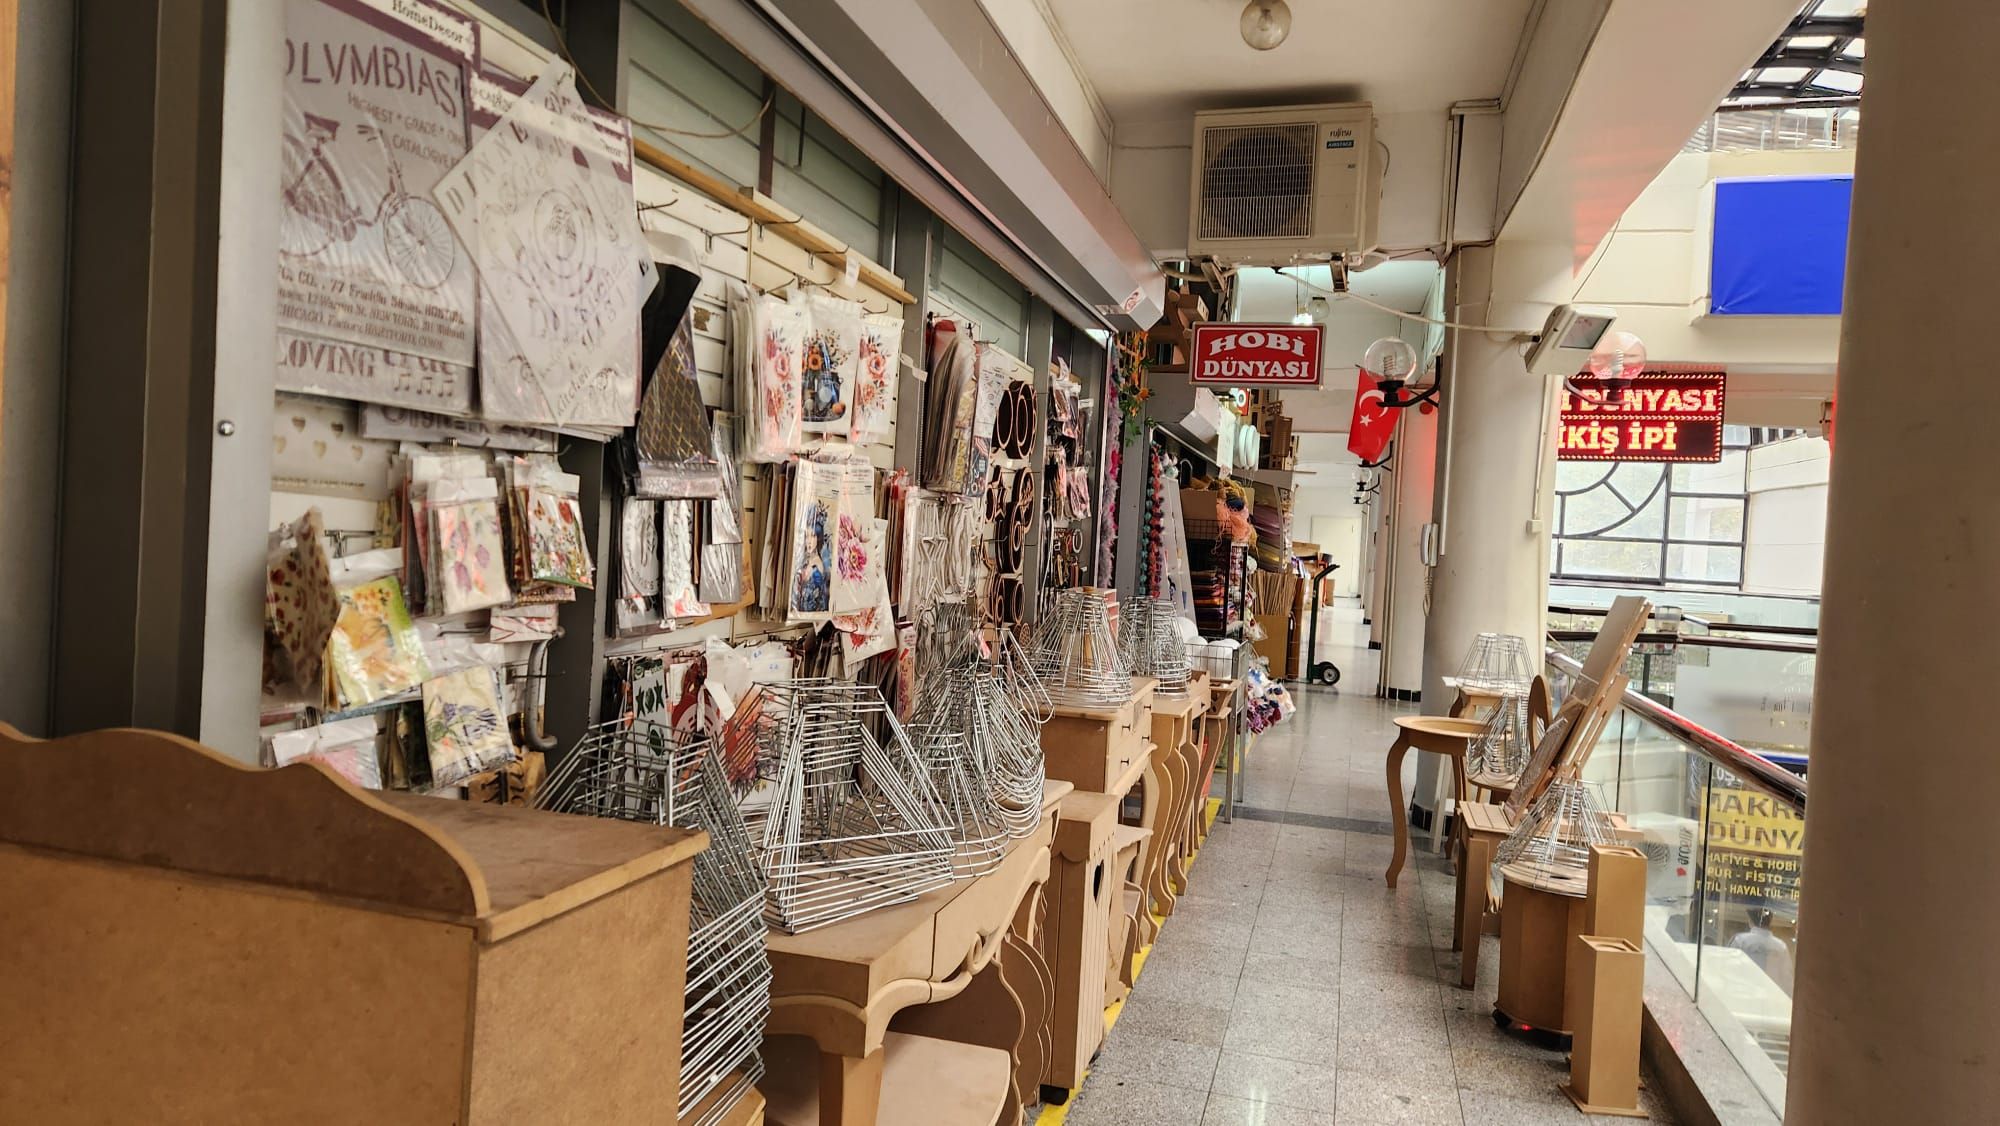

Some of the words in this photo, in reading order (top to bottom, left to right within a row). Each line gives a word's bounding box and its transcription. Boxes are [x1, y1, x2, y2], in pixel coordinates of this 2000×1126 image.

[1208, 331, 1307, 358] HOBİ
[1202, 355, 1310, 379] DÜNYASI
[1628, 420, 1678, 450] İPİ
[1729, 883, 1763, 898] HAYAL
